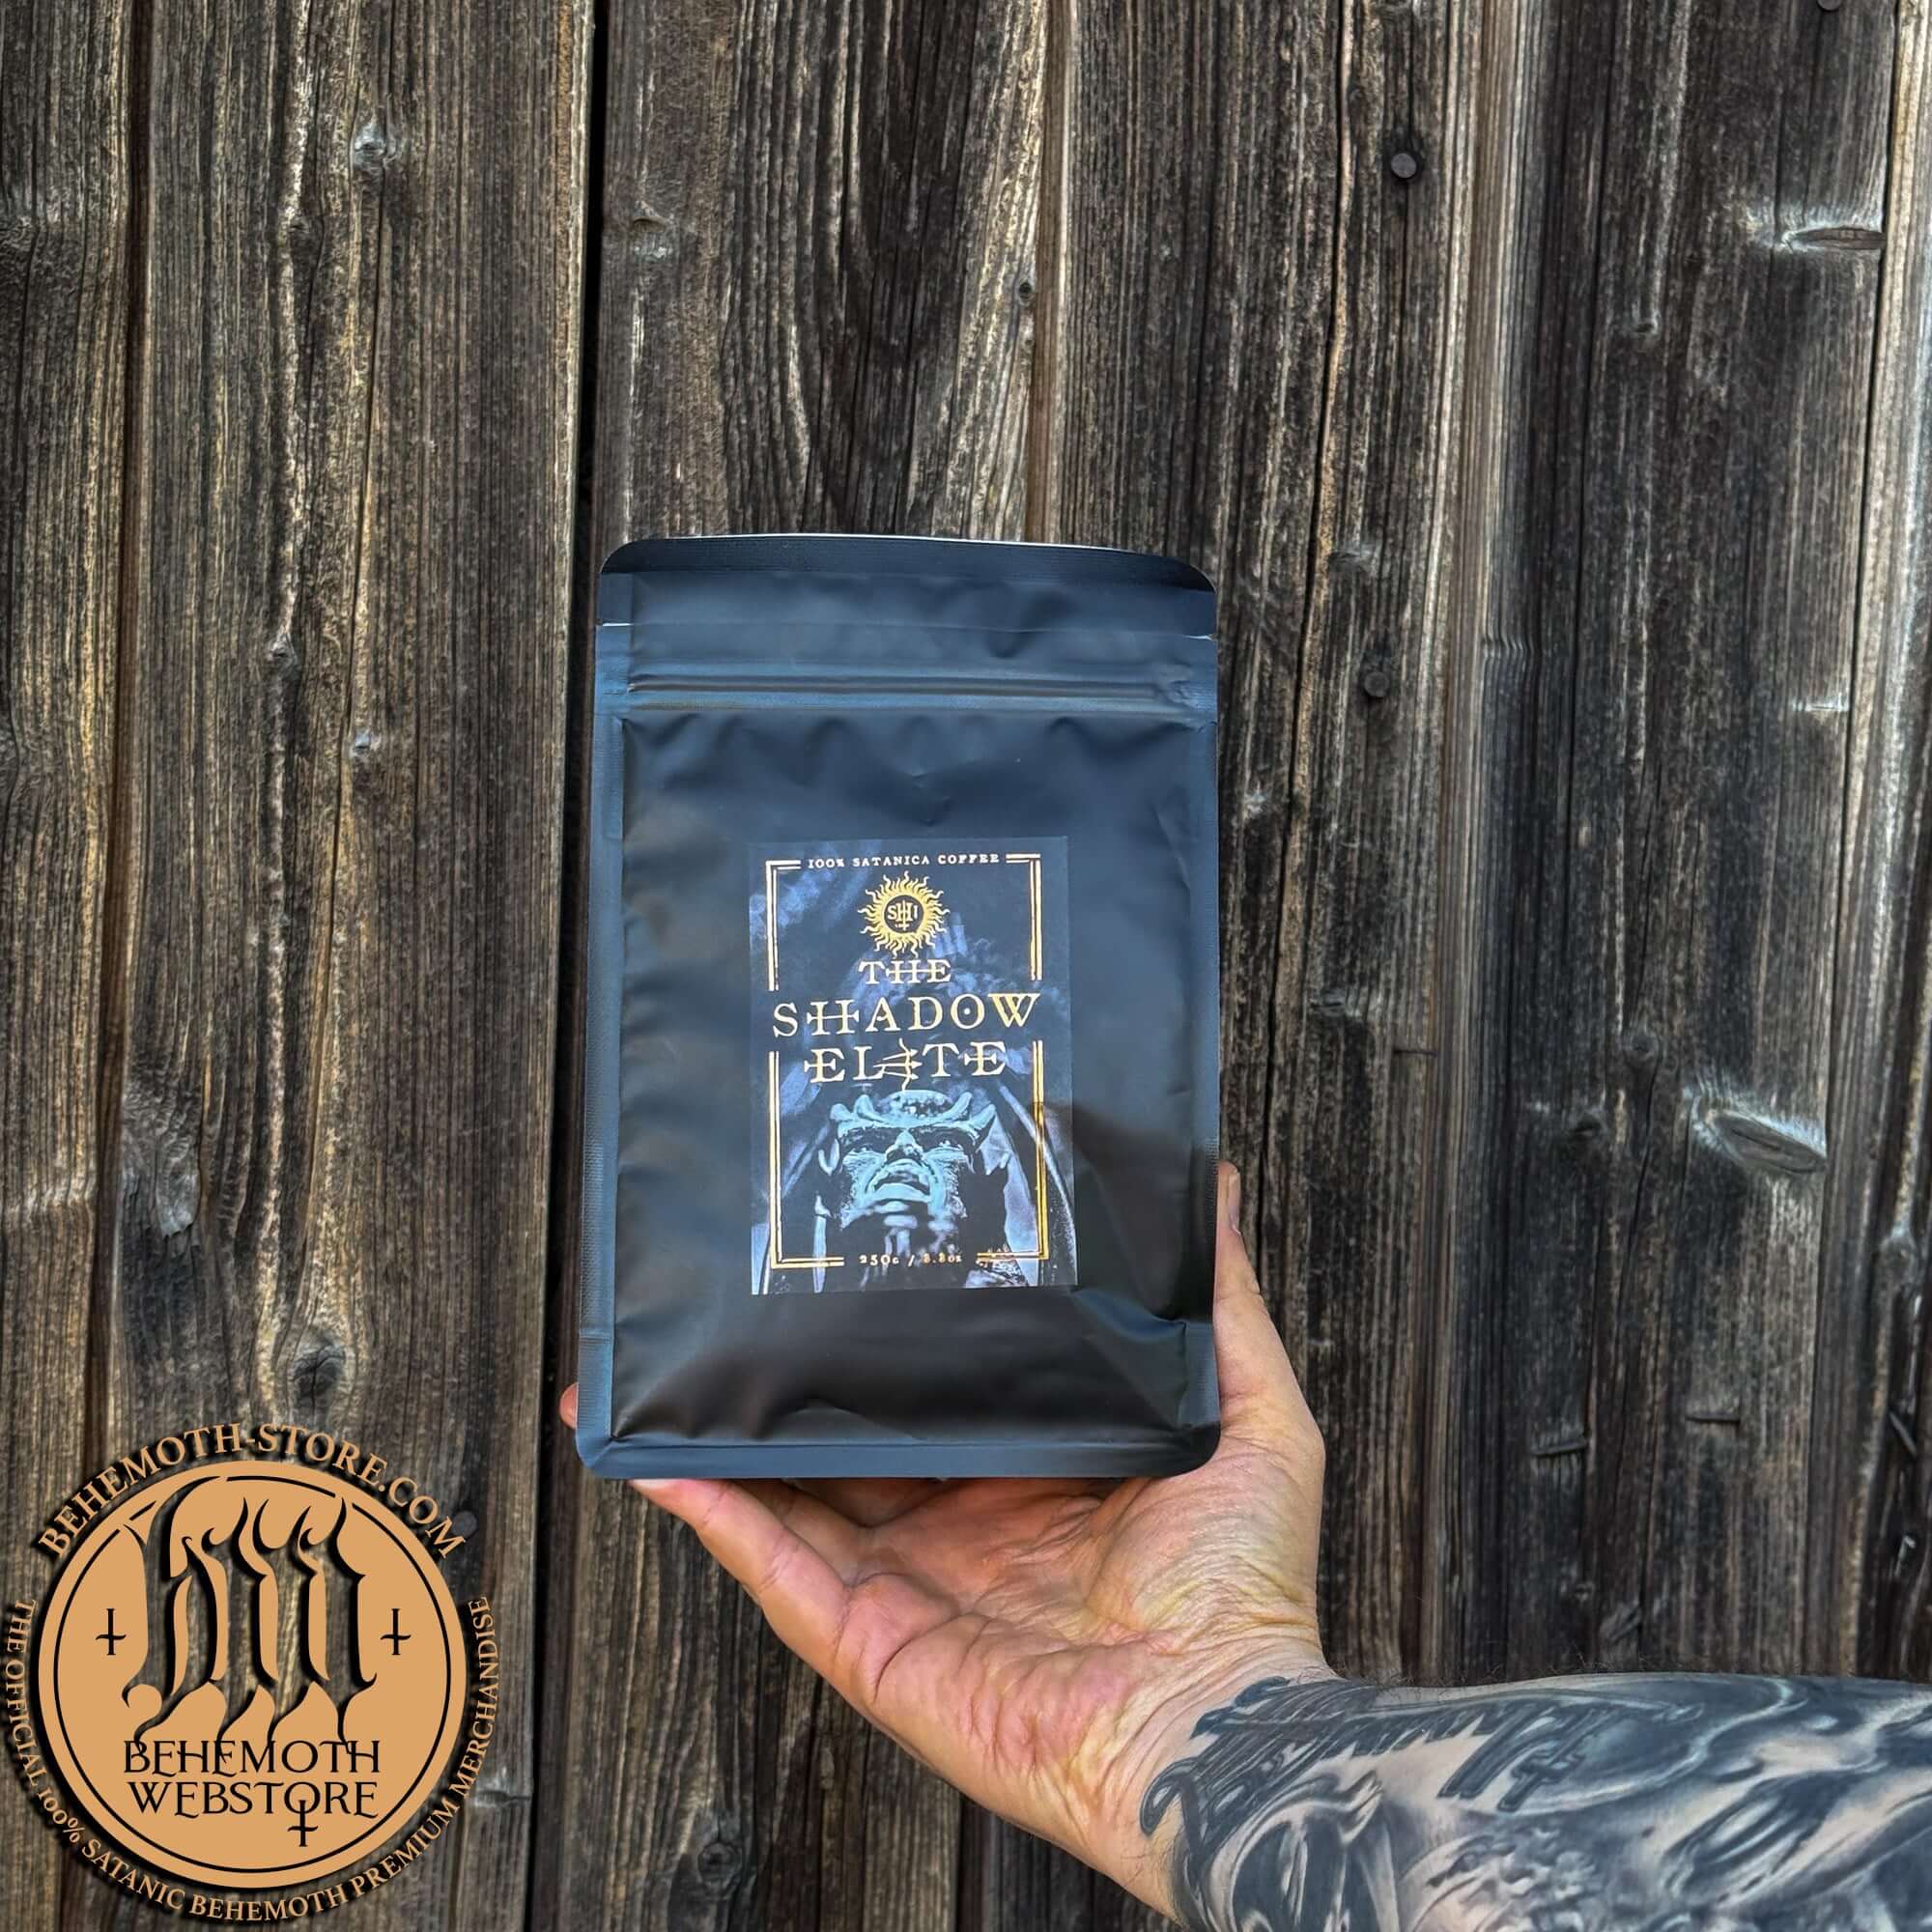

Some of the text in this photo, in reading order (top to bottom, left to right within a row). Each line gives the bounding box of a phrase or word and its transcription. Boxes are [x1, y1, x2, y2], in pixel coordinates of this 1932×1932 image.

[808, 853, 999, 868] 100% SATANICA COFFEE
[858, 959, 952, 985] THE
[772, 993, 1041, 1038] SHADOW
[804, 1038, 1008, 1091] ELITE
